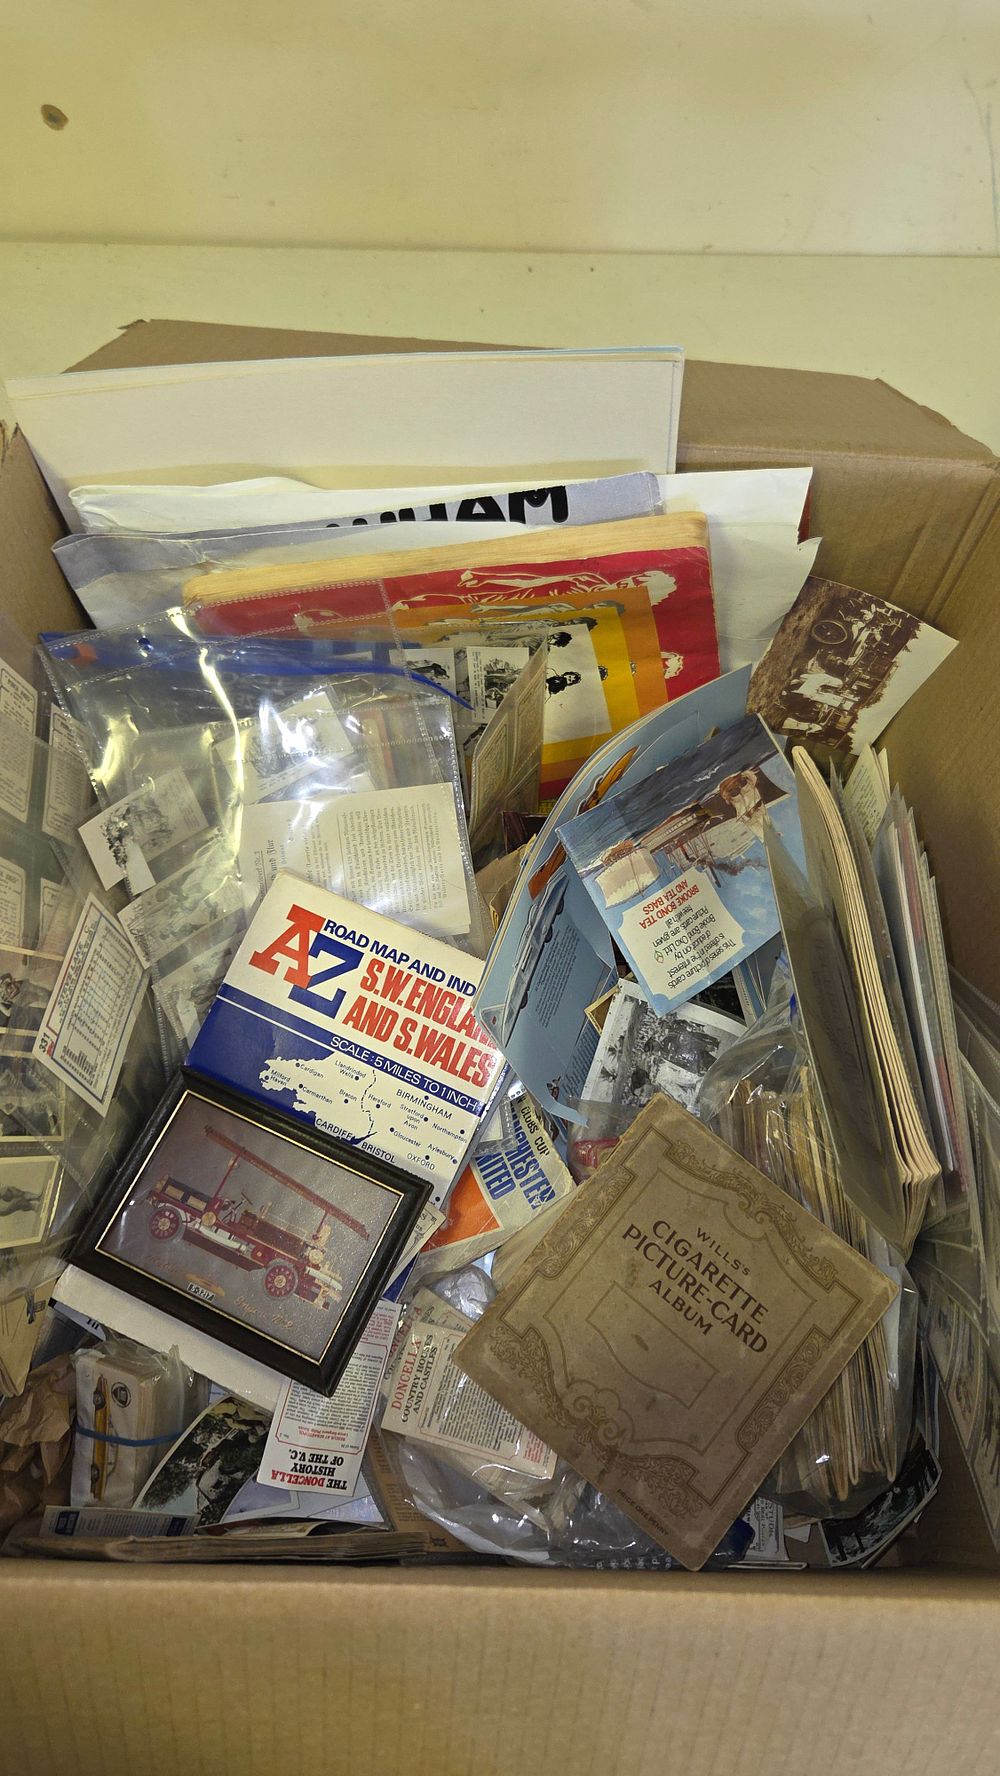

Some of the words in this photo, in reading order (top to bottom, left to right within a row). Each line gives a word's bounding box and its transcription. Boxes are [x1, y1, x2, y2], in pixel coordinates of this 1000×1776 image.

[661, 888, 676, 902] TEA
[673, 879, 689, 893] AND
[674, 884, 700, 905] BROOKE
[641, 896, 664, 915] BAGS
[654, 900, 677, 919] BOND
[690, 905, 709, 922] Picture
[638, 914, 657, 929] TEA
[669, 925, 681, 936] are
[697, 913, 716, 930] Brooke
[651, 931, 671, 948] given
[674, 934, 689, 948] Oxo
[685, 925, 701, 939] Bond
[680, 933, 707, 955] education
[702, 936, 722, 952] offered
[708, 946, 724, 960] series
[722, 938, 736, 952] This
[70, 942, 84, 970] LAKE
[323, 918, 371, 949] ROAD
[369, 939, 412, 969] MAP
[408, 957, 447, 984] AND
[446, 974, 477, 997] IND
[672, 949, 684, 962] by
[666, 957, 691, 978] interest
[684, 959, 706, 978] picture
[667, 973, 687, 989] cards
[341, 992, 400, 1043] AND
[39, 1032, 52, 1053] 331
[299, 1063, 324, 1080] Cardigan
[383, 1060, 421, 1085] MILES
[420, 1077, 441, 1094] TO
[446, 1089, 478, 1110] INCH
[301, 1086, 333, 1104] Carmarthen
[338, 1089, 358, 1101] Brecon
[367, 1093, 391, 1108] Hereford
[395, 1088, 452, 1120] BIRMINGHAM
[399, 1103, 424, 1119] Stratford
[405, 1114, 420, 1125] upon
[315, 1117, 352, 1141] CARDIFF
[403, 1120, 418, 1130] Avon
[431, 1122, 468, 1144] Northampton
[520, 1105, 538, 1133] CLUBS
[532, 1136, 550, 1157] CUP
[392, 1130, 421, 1147] Gloucester
[360, 1140, 397, 1164] BRISTOL
[426, 1143, 454, 1161] Aylesbury
[406, 1152, 435, 1171] OXFORD
[474, 1152, 516, 1200] NITED
[649, 1217, 769, 1324] CIGARETTE
[621, 1222, 770, 1354] PICTURE-CARD
[648, 1281, 714, 1335] ALBUM
[390, 1336, 421, 1410] DONCELLA
[400, 1374, 421, 1422] COUNTRY
[416, 1333, 433, 1372] HOUSES
[411, 1390, 424, 1413] AND
[418, 1345, 437, 1390] CASTLES
[287, 1448, 306, 1461] V.C.
[308, 1452, 328, 1464] THE
[329, 1455, 343, 1465] OF
[271, 1469, 324, 1487] DONCELLA
[290, 1462, 335, 1476] HISTORY
[326, 1477, 347, 1489] THE
